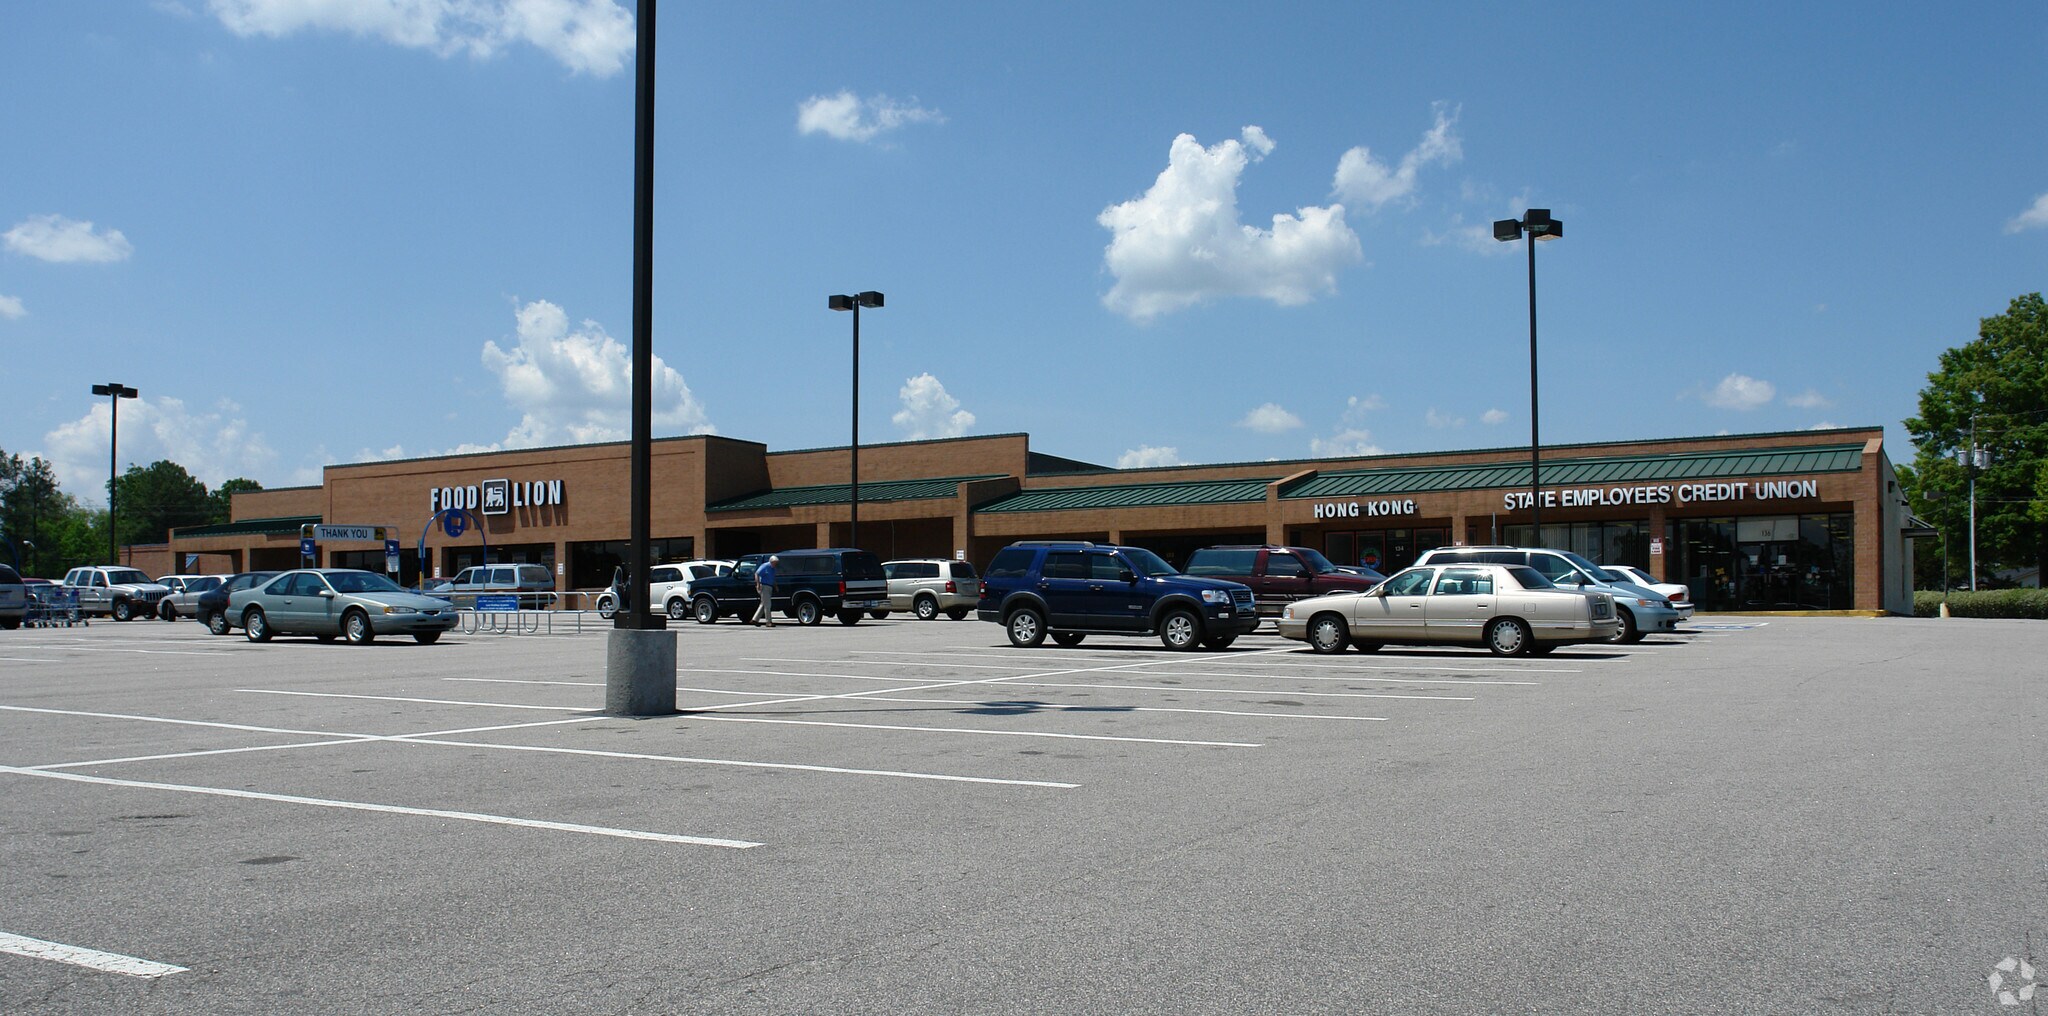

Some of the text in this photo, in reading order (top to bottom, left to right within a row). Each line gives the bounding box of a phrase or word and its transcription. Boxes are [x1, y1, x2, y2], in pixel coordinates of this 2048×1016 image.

[430, 479, 562, 512] FOOD LION
[1504, 480, 1817, 510] STATE EMPLOYEES' CREDIT UNION
[1314, 499, 1414, 519] HONG KONG
[321, 528, 368, 539] THANK YOU
